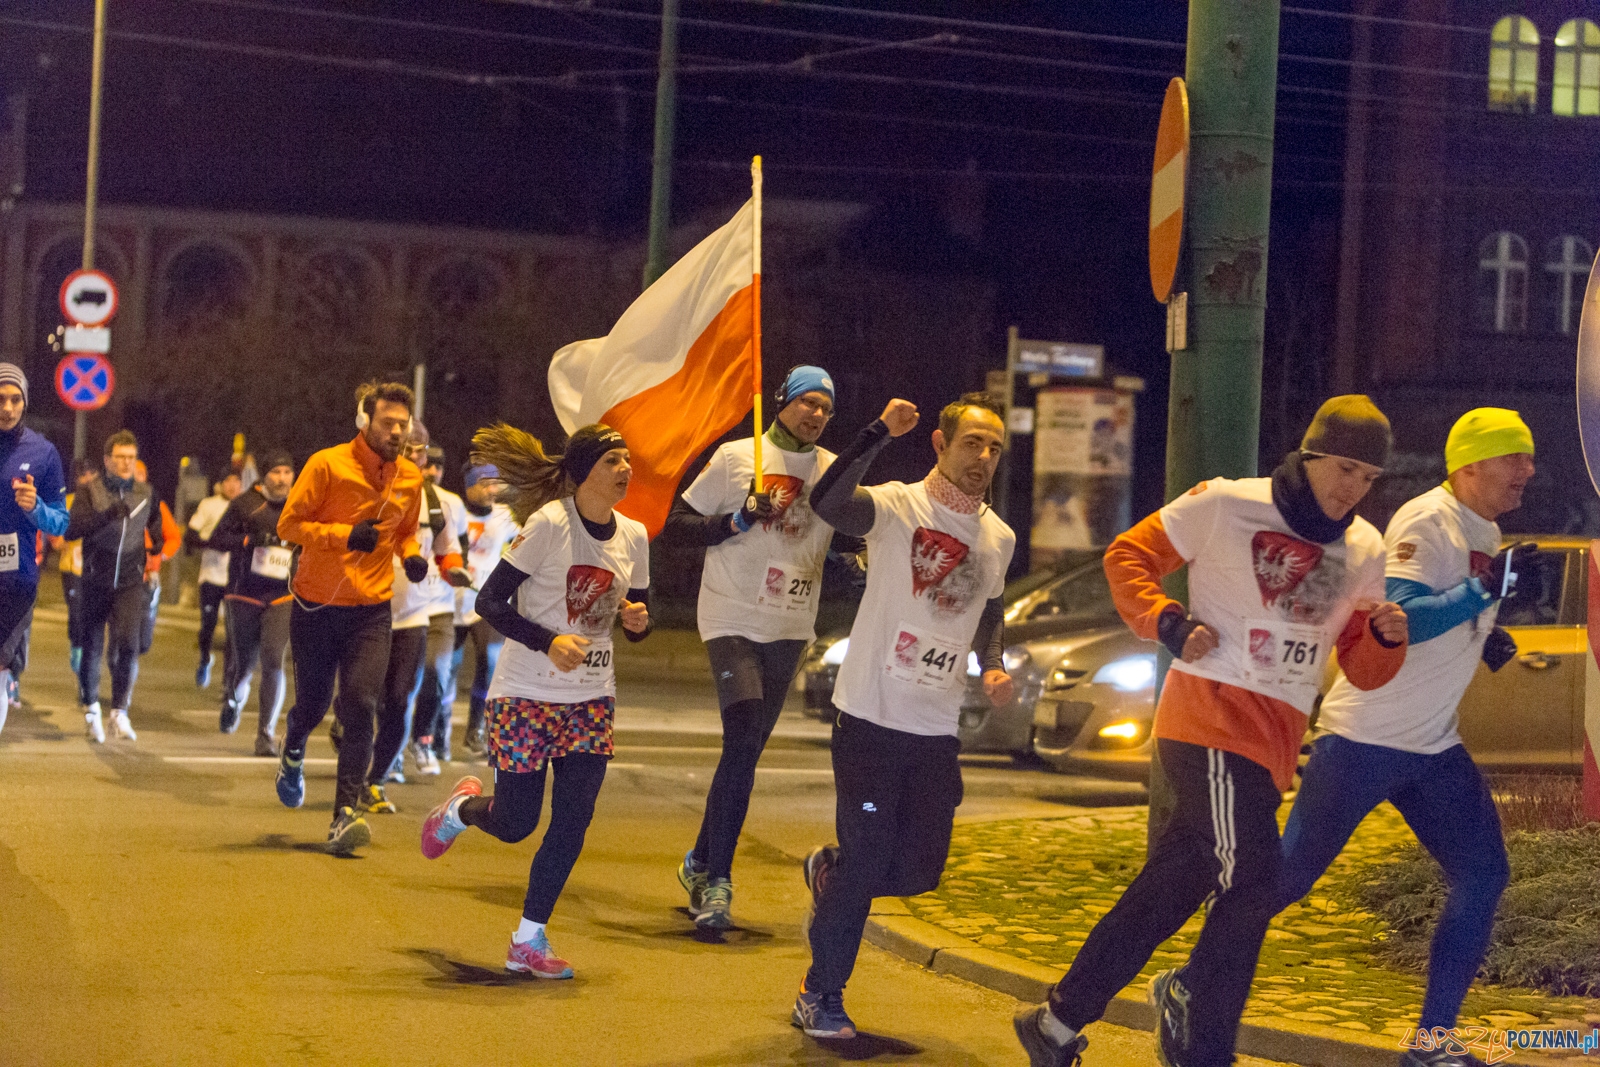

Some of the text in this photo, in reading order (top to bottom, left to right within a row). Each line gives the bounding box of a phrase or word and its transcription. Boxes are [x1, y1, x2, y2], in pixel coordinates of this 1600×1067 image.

[788, 578, 813, 597] 279
[582, 649, 611, 668] 420
[921, 647, 958, 673] 441
[1282, 640, 1318, 665] 761
